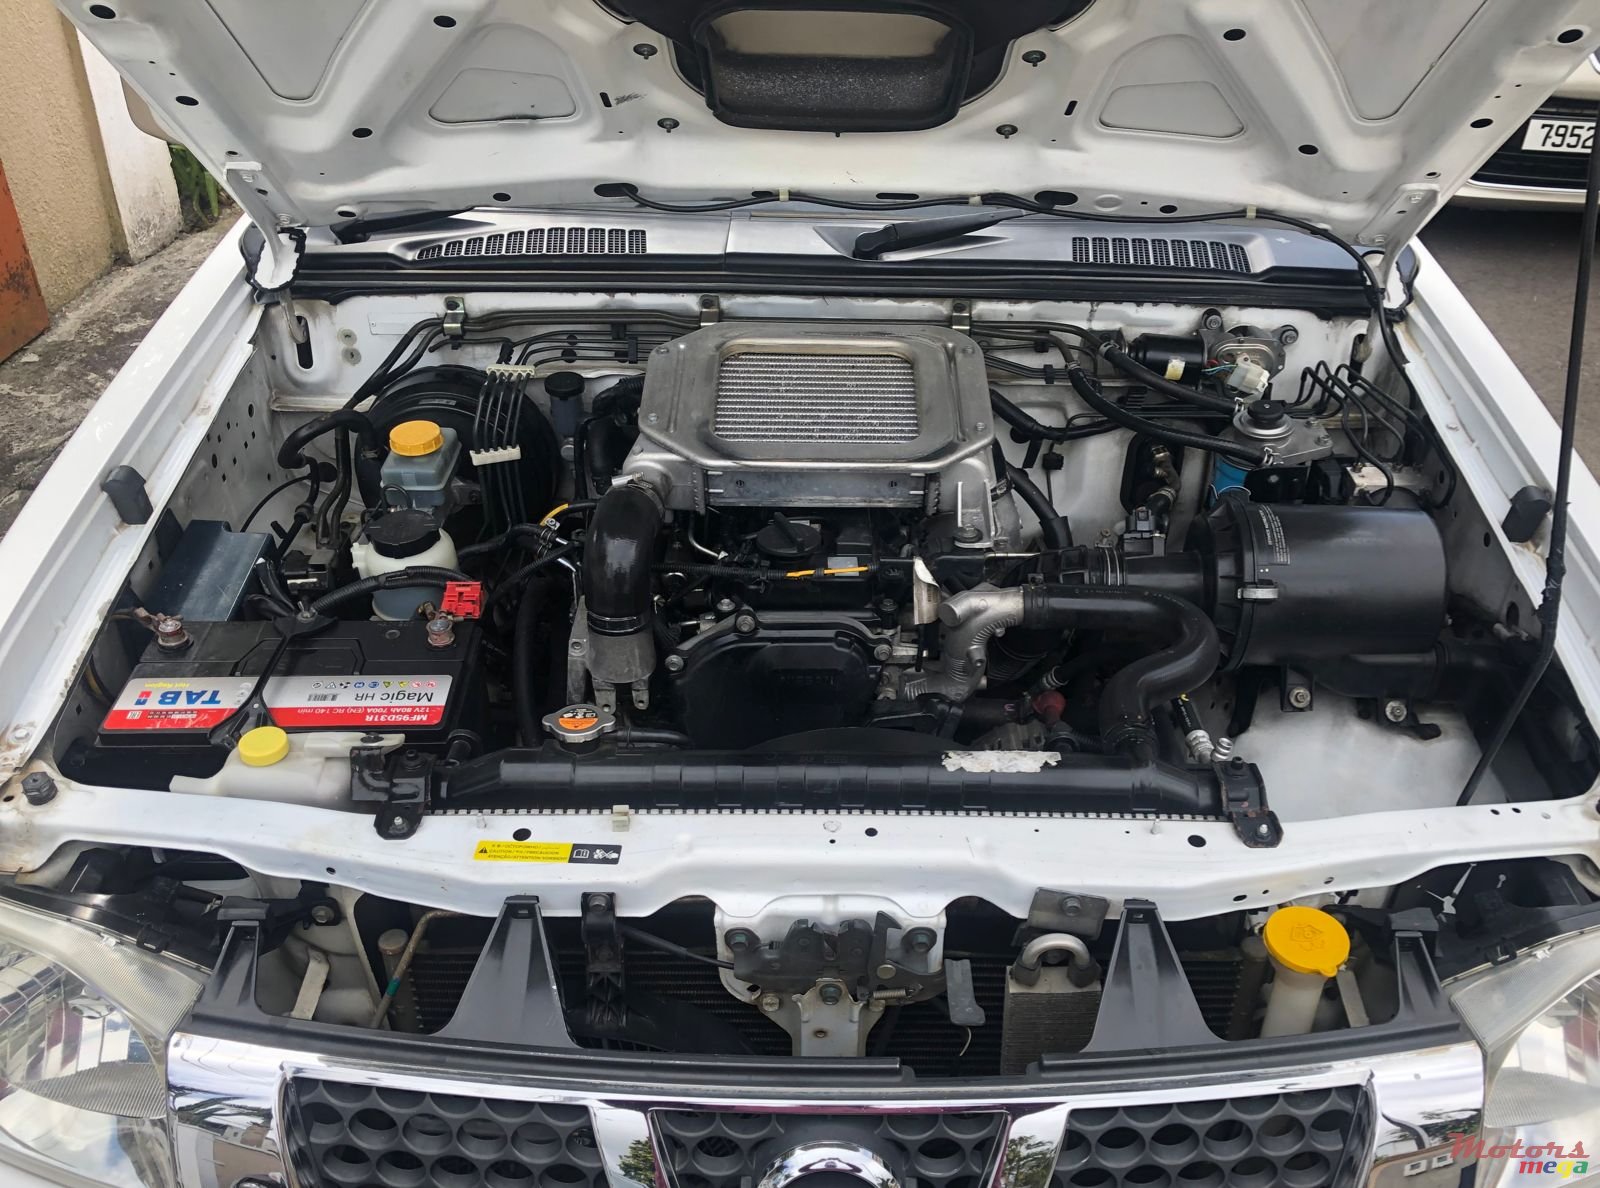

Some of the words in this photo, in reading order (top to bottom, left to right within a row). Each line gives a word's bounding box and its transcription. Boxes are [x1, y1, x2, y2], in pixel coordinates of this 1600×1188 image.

[158, 690, 221, 705] TAB
[354, 693, 375, 701] HR
[380, 690, 434, 703] Magic
[365, 714, 428, 722] MF95D31R
